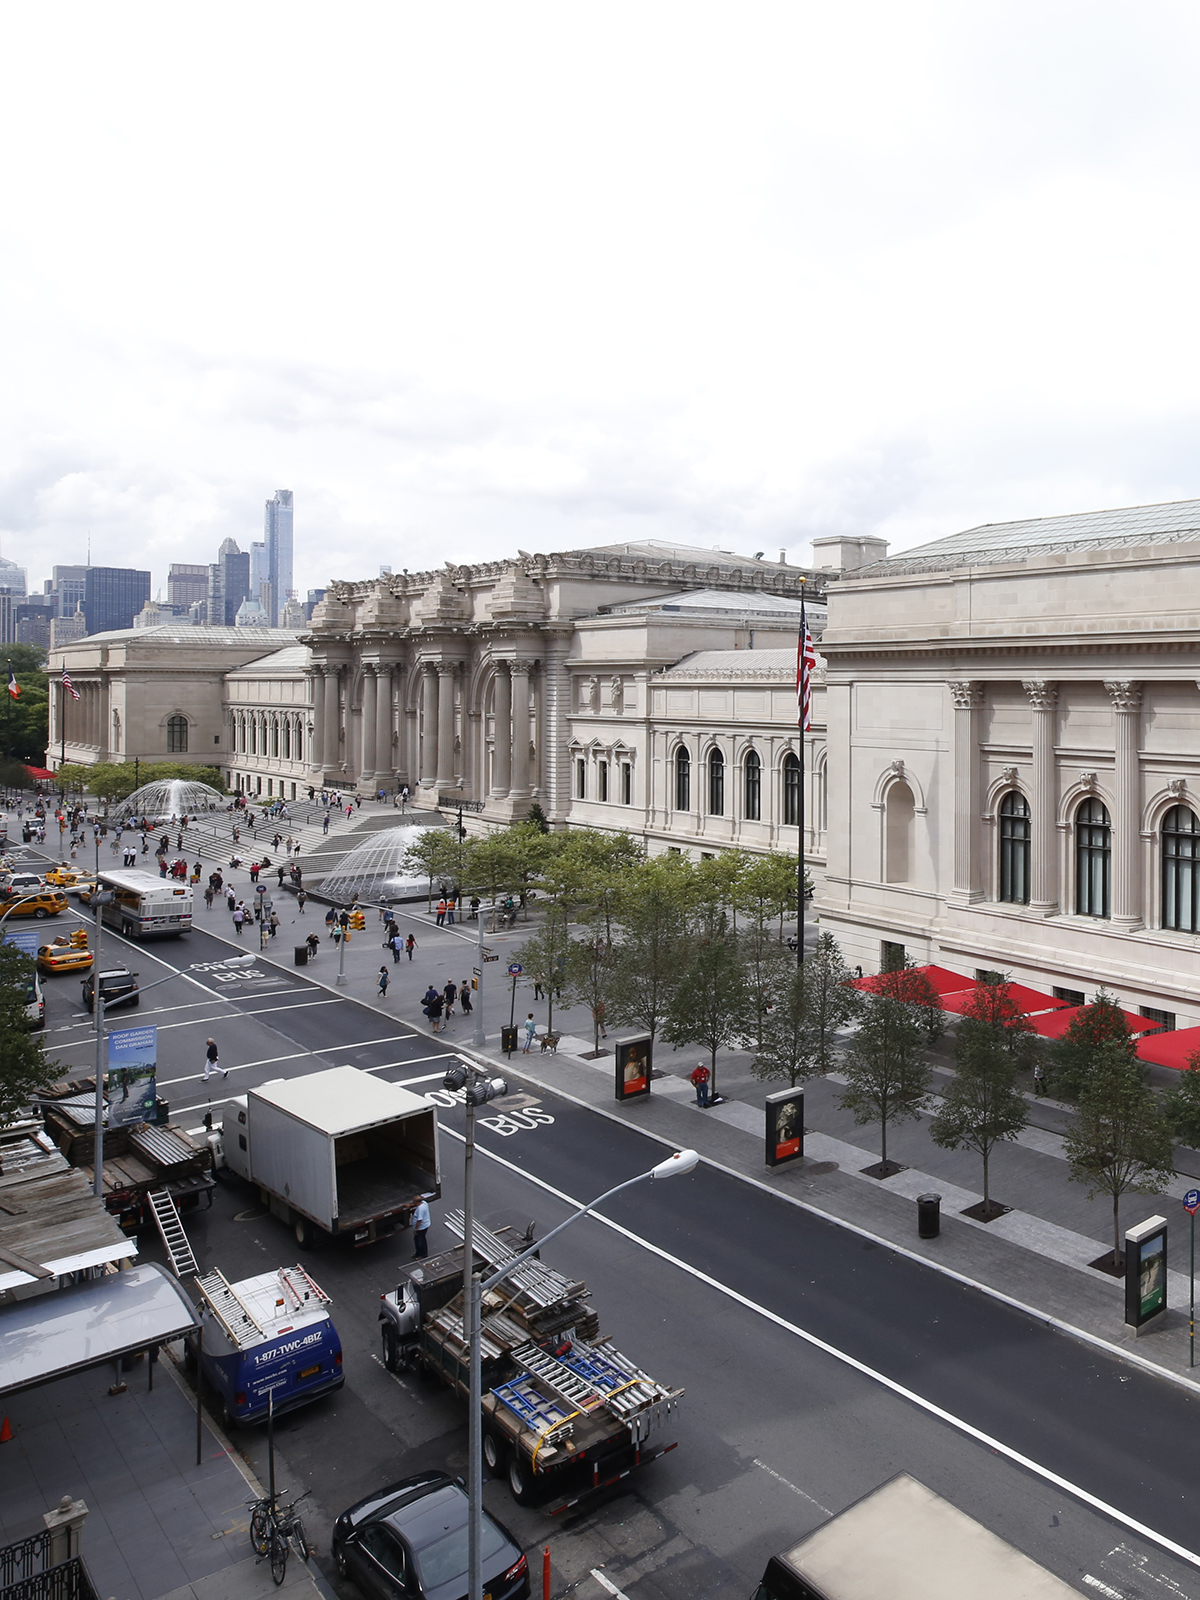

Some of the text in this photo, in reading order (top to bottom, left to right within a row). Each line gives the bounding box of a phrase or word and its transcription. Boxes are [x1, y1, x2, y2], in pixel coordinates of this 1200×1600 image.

[212, 969, 266, 982] BUS
[130, 1029, 154, 1037] GARDEN
[129, 1039, 154, 1048] GRAHAM
[476, 1107, 555, 1137] BUS
[254, 1331, 323, 1365] 1-877-TWC-4BIZ
